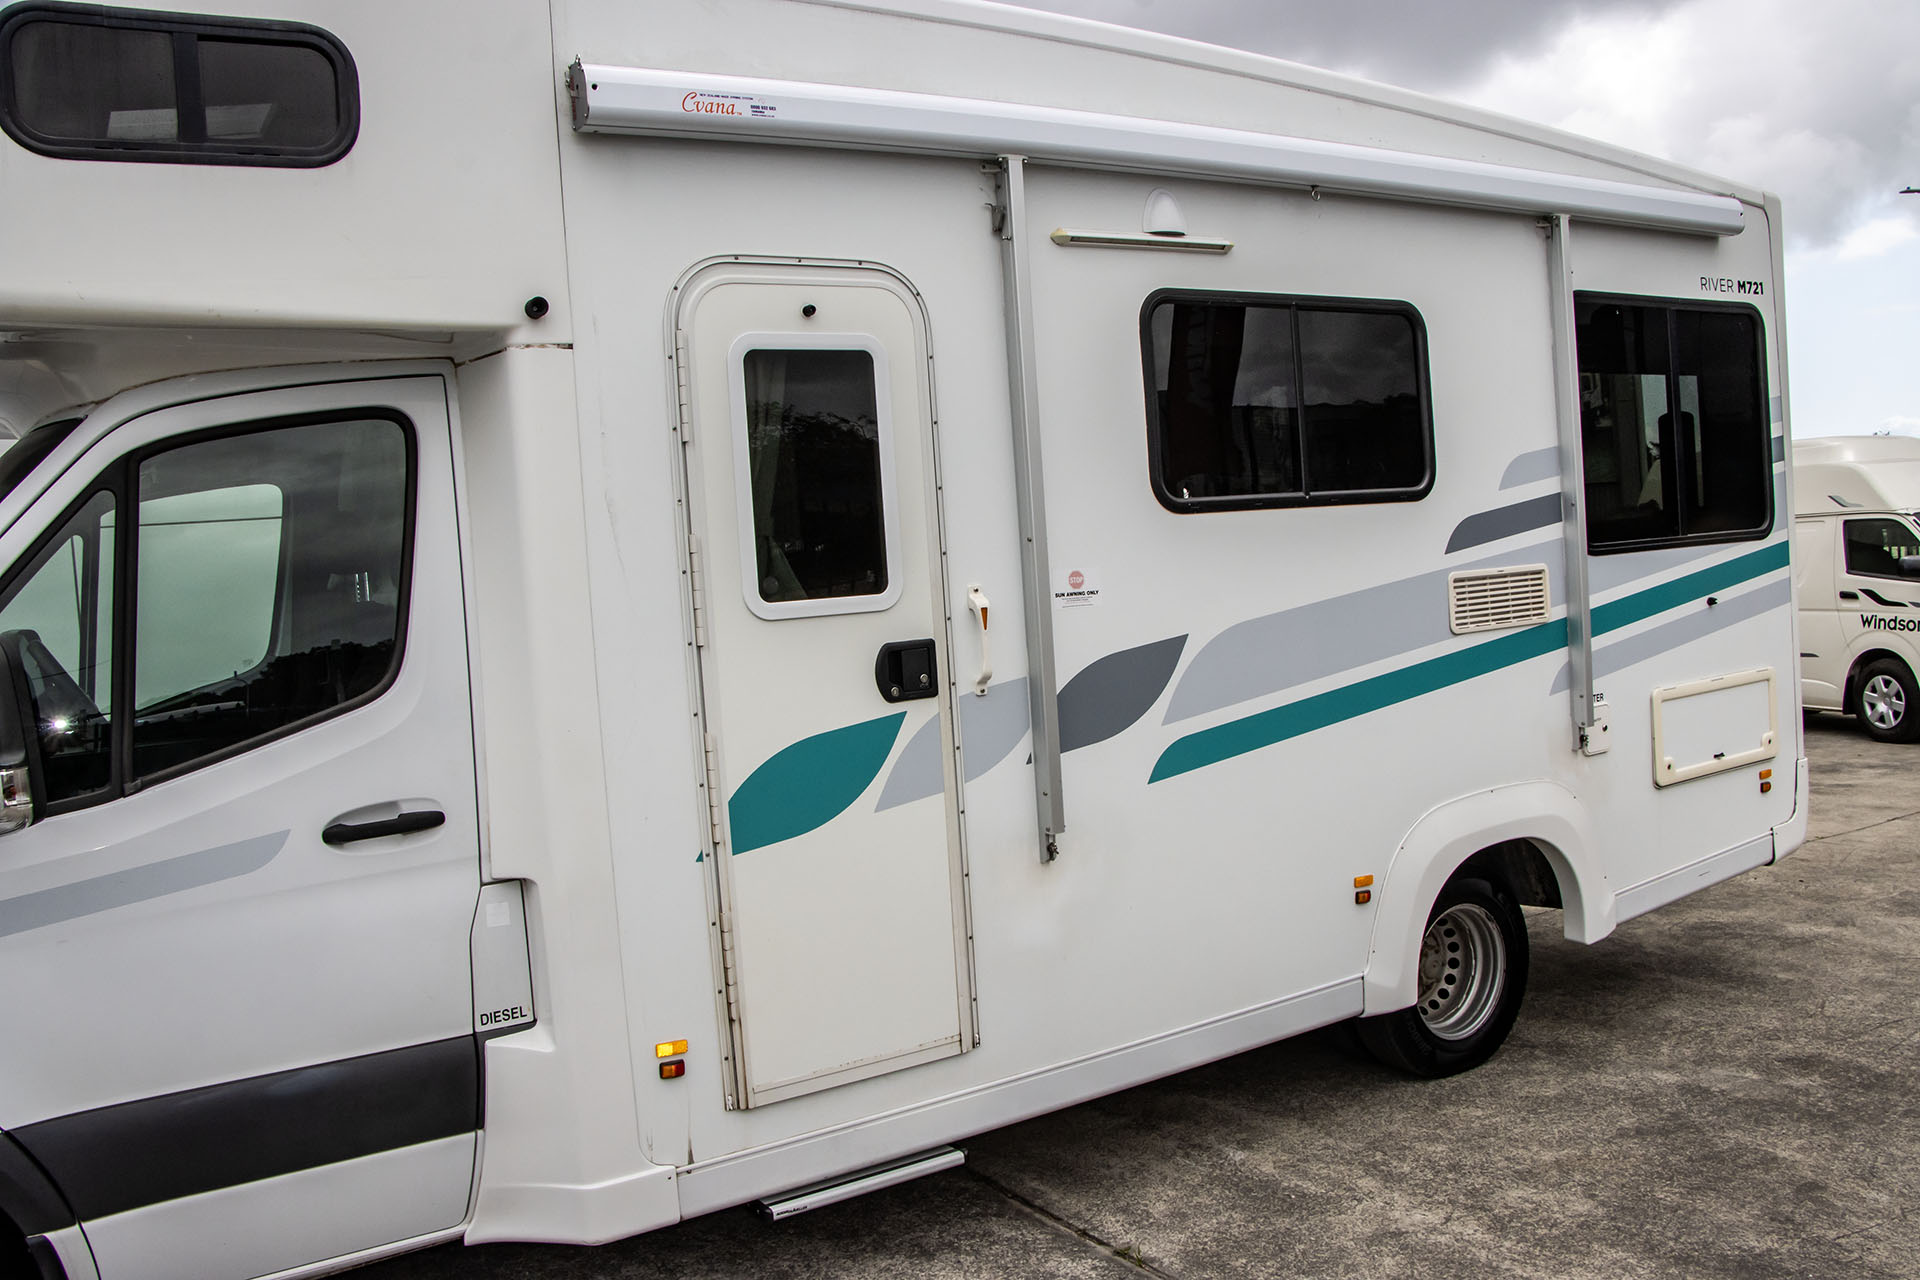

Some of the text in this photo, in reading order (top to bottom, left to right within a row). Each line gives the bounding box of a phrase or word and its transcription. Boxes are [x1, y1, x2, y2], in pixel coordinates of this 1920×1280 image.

[682, 92, 735, 115] Cvana
[1700, 276, 1764, 295] RIVER M721
[1593, 693, 1604, 702] TER
[480, 1006, 527, 1026] DIESEL
